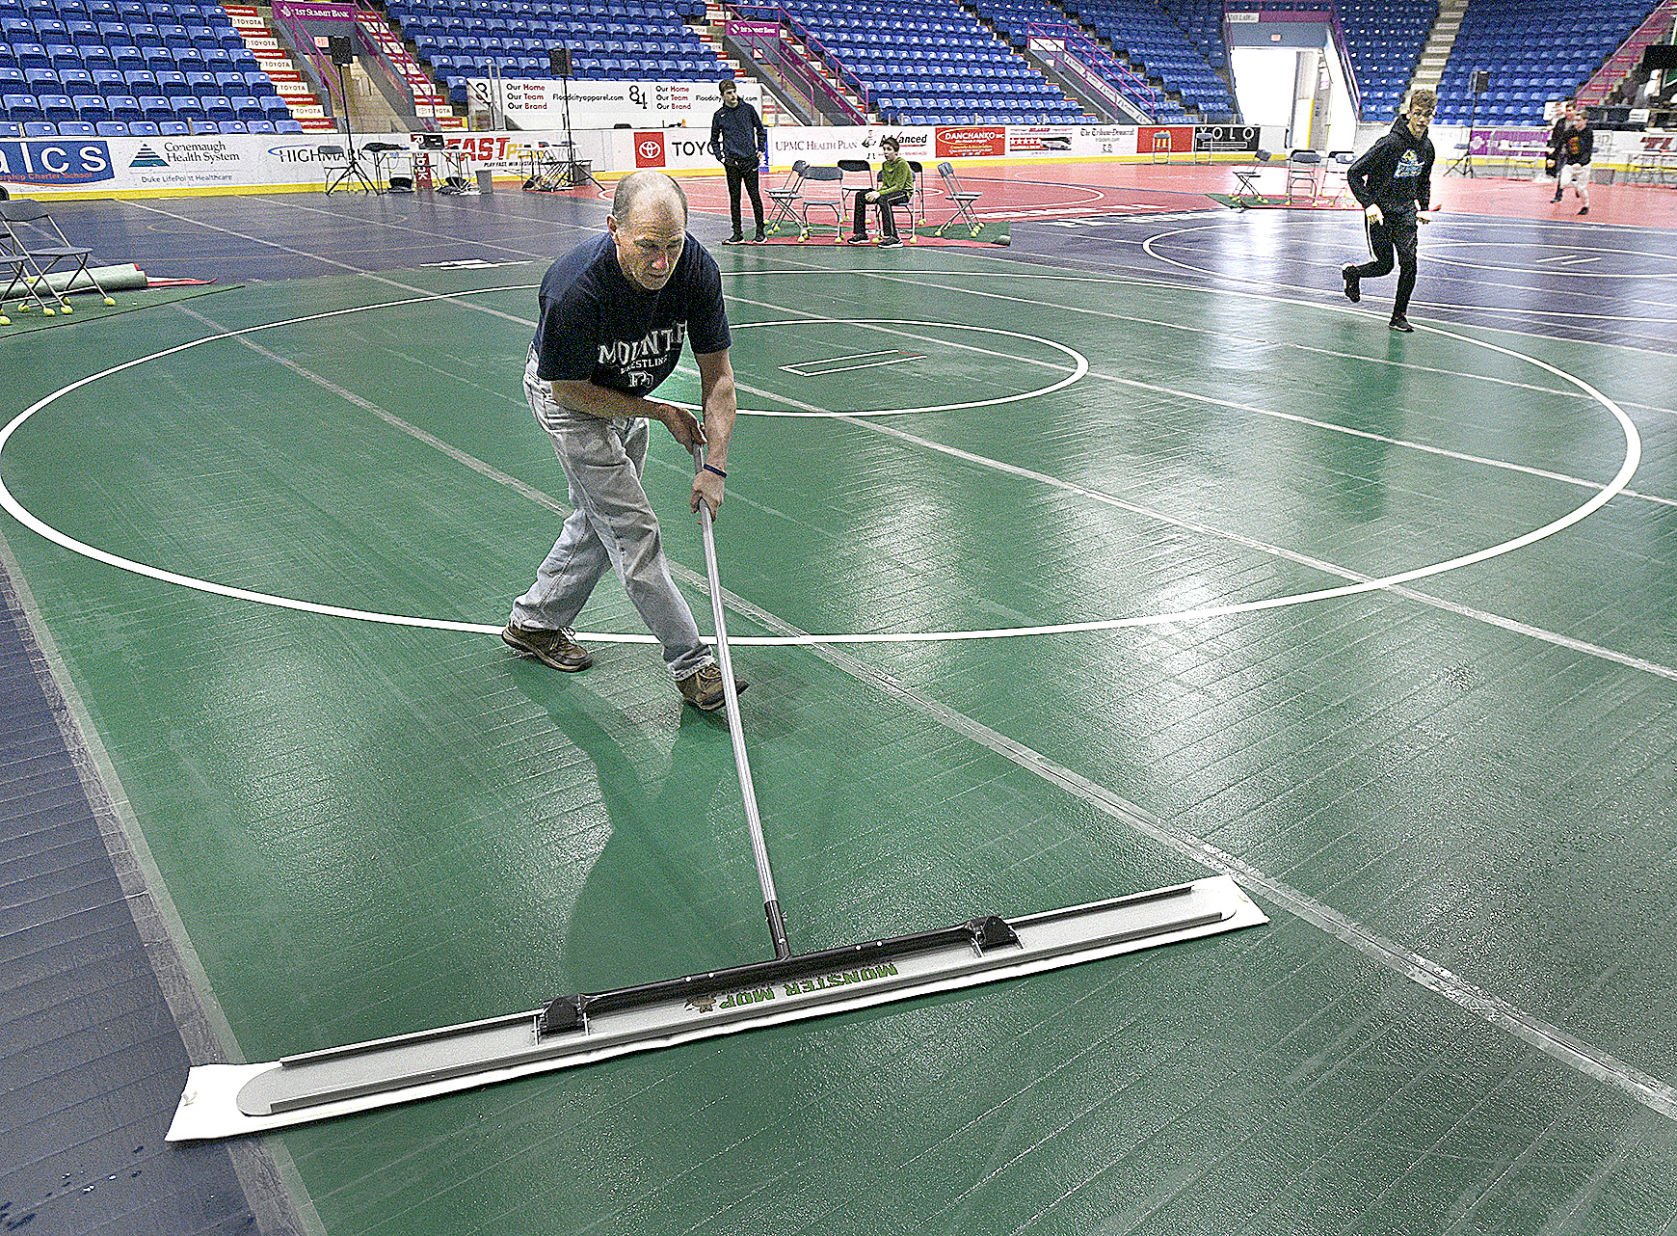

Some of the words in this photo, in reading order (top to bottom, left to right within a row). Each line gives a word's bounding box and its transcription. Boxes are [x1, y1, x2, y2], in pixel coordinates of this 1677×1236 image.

[332, 9, 350, 18] BANK
[524, 102, 548, 110] Brand
[945, 132, 995, 140] DANCHANKO
[164, 140, 227, 152] Conemaugh
[775, 140, 804, 151] UPMC
[837, 140, 858, 150] PLAN
[166, 152, 201, 163] Health
[203, 152, 240, 164] System
[279, 148, 367, 163] HIGHMAK
[195, 174, 233, 182] Healthcare
[783, 962, 899, 997] MONSTER
[718, 987, 776, 1009] MOP
